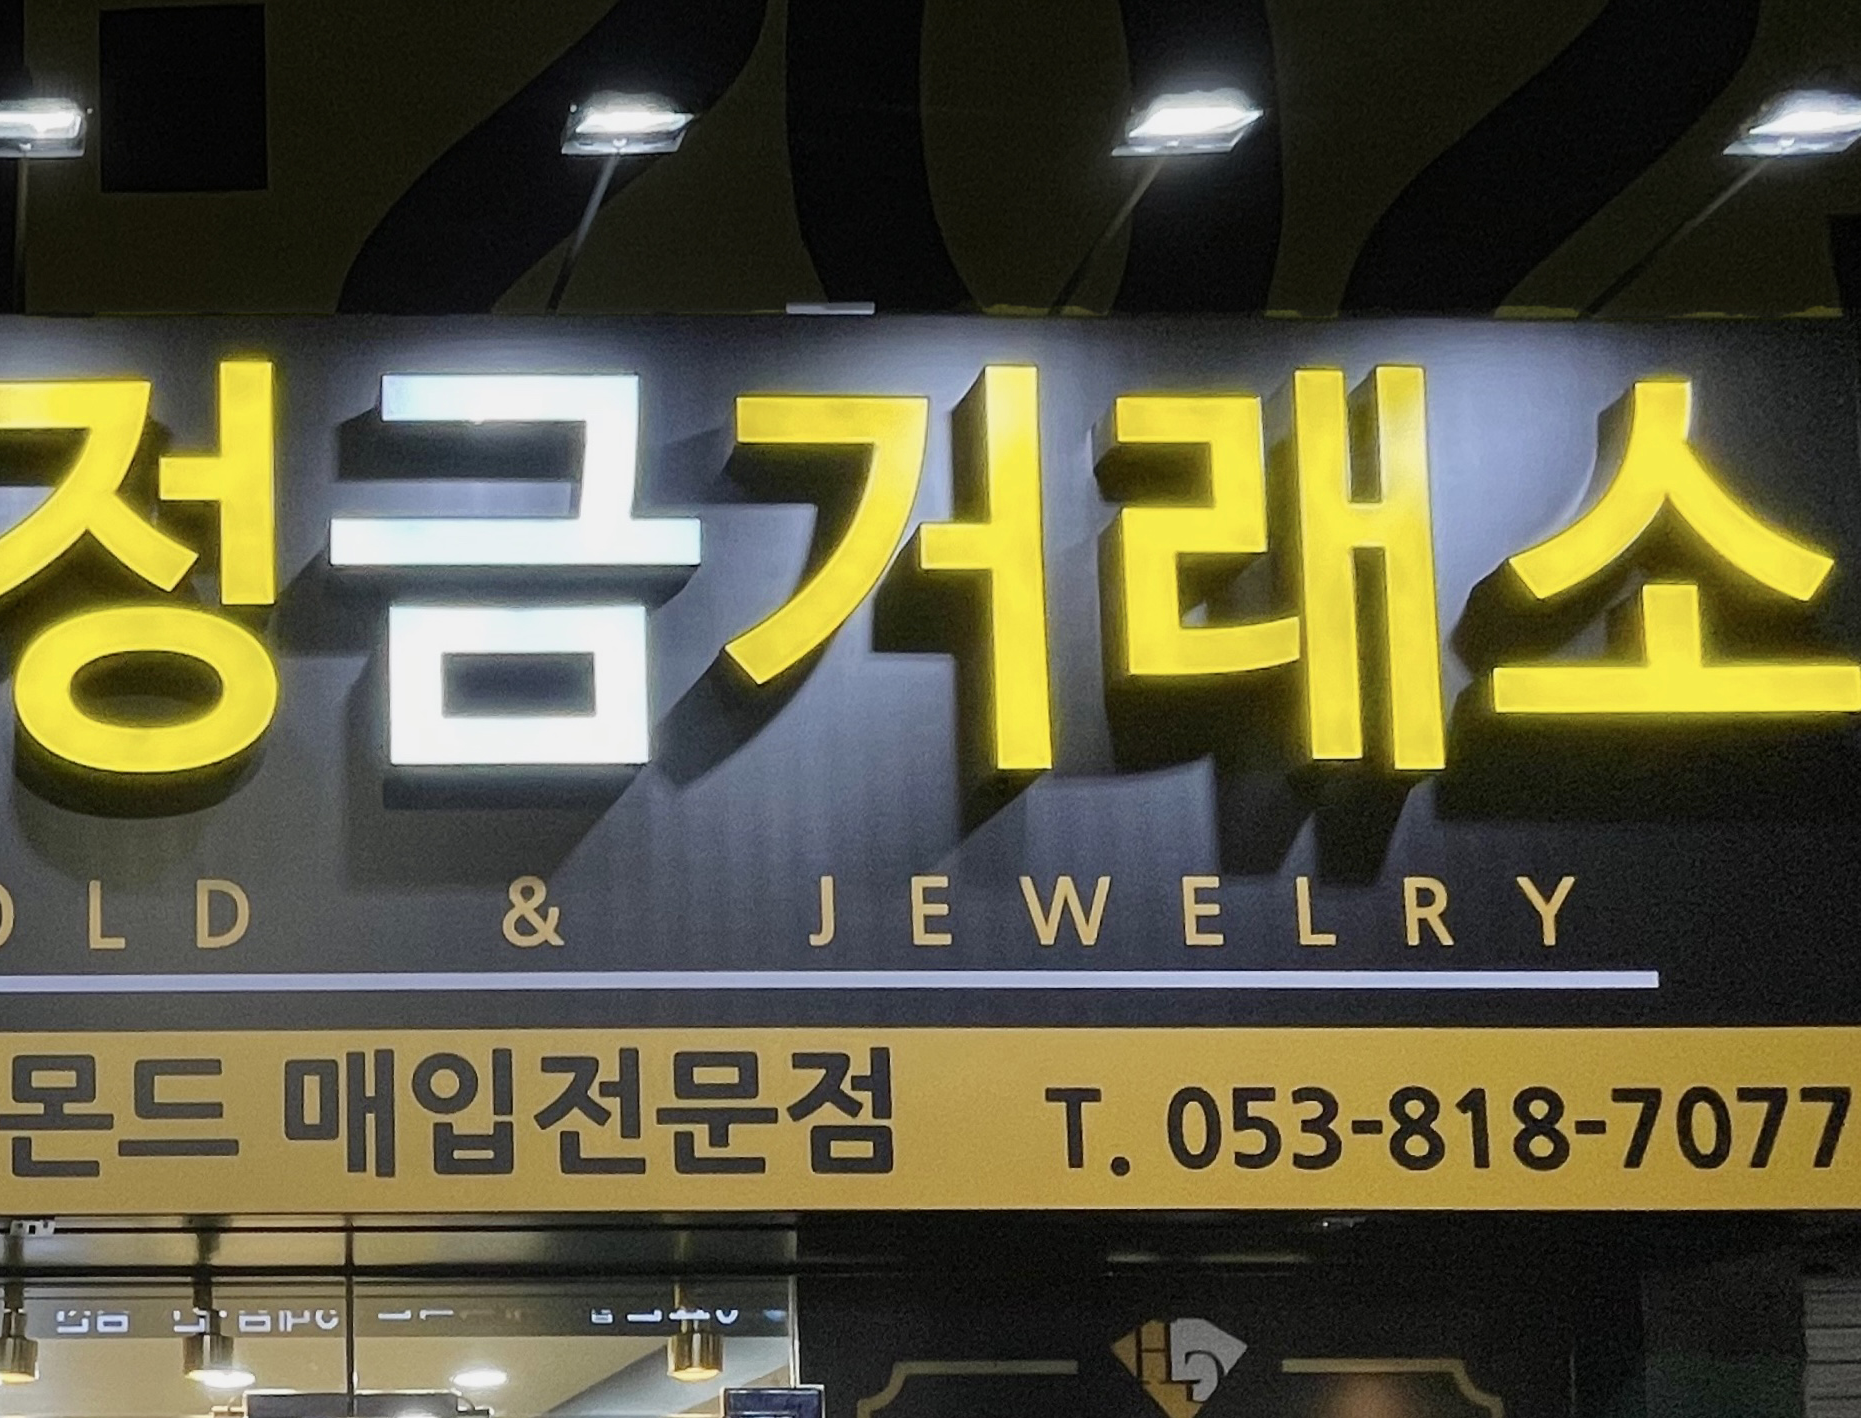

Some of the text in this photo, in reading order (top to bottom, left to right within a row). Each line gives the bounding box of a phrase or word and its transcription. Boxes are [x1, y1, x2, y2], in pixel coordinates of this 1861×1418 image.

[502, 876, 565, 948] &
[811, 875, 1575, 948] JEWELRY
[284, 1047, 895, 1178] 매입전문점
[1045, 1086, 1853, 1178] T. 053-818-7077
